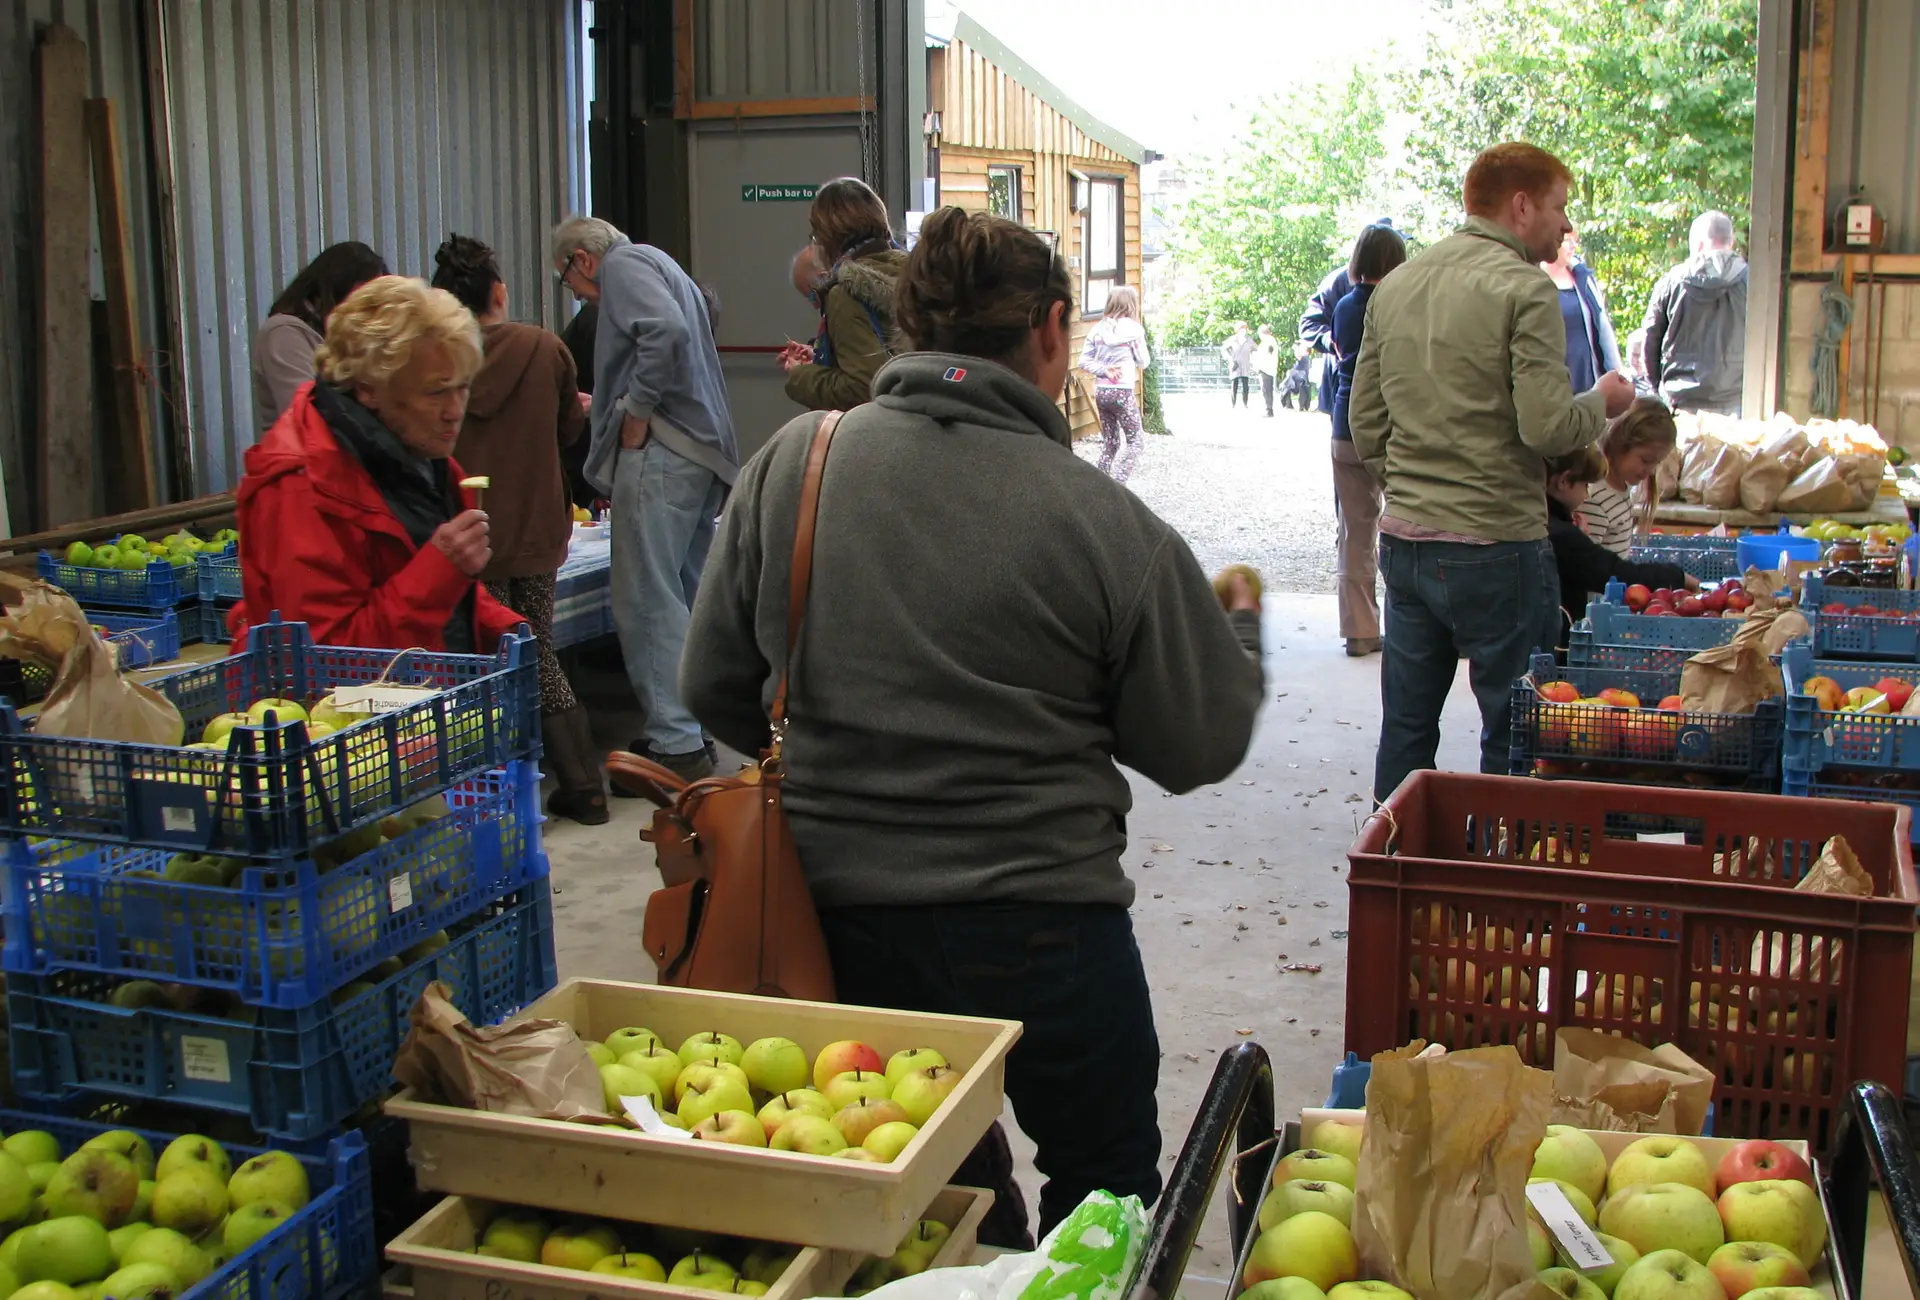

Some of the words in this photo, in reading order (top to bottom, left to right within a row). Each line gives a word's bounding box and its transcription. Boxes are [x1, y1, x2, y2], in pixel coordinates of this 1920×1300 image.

[759, 188, 782, 198] Push
[785, 188, 800, 198] bar
[803, 188, 813, 198] to
